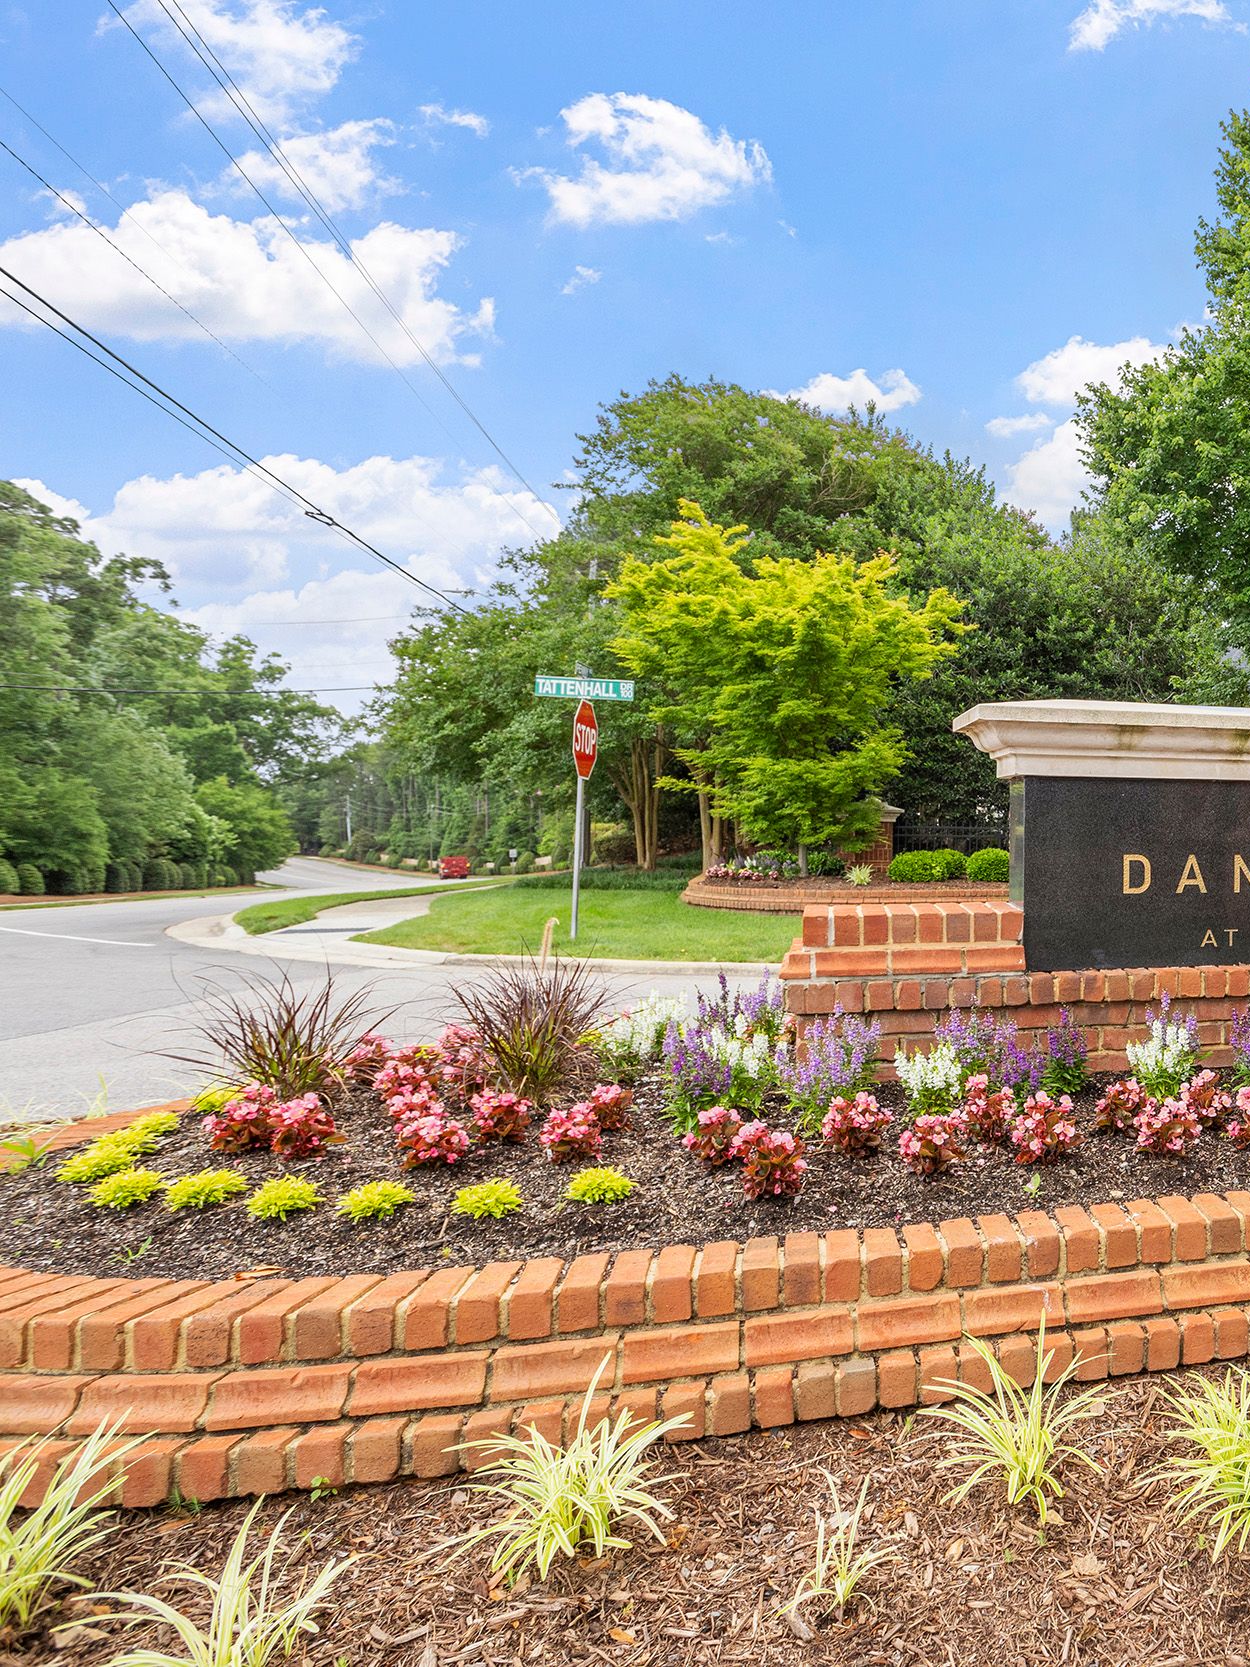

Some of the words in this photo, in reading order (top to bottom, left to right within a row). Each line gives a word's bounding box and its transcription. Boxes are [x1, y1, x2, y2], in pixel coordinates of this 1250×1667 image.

[536, 679, 617, 697] TATTENHALL
[620, 682, 633, 690] DR
[620, 690, 633, 698] 100
[575, 723, 596, 755] STOP
[1200, 928, 1239, 948] AT
